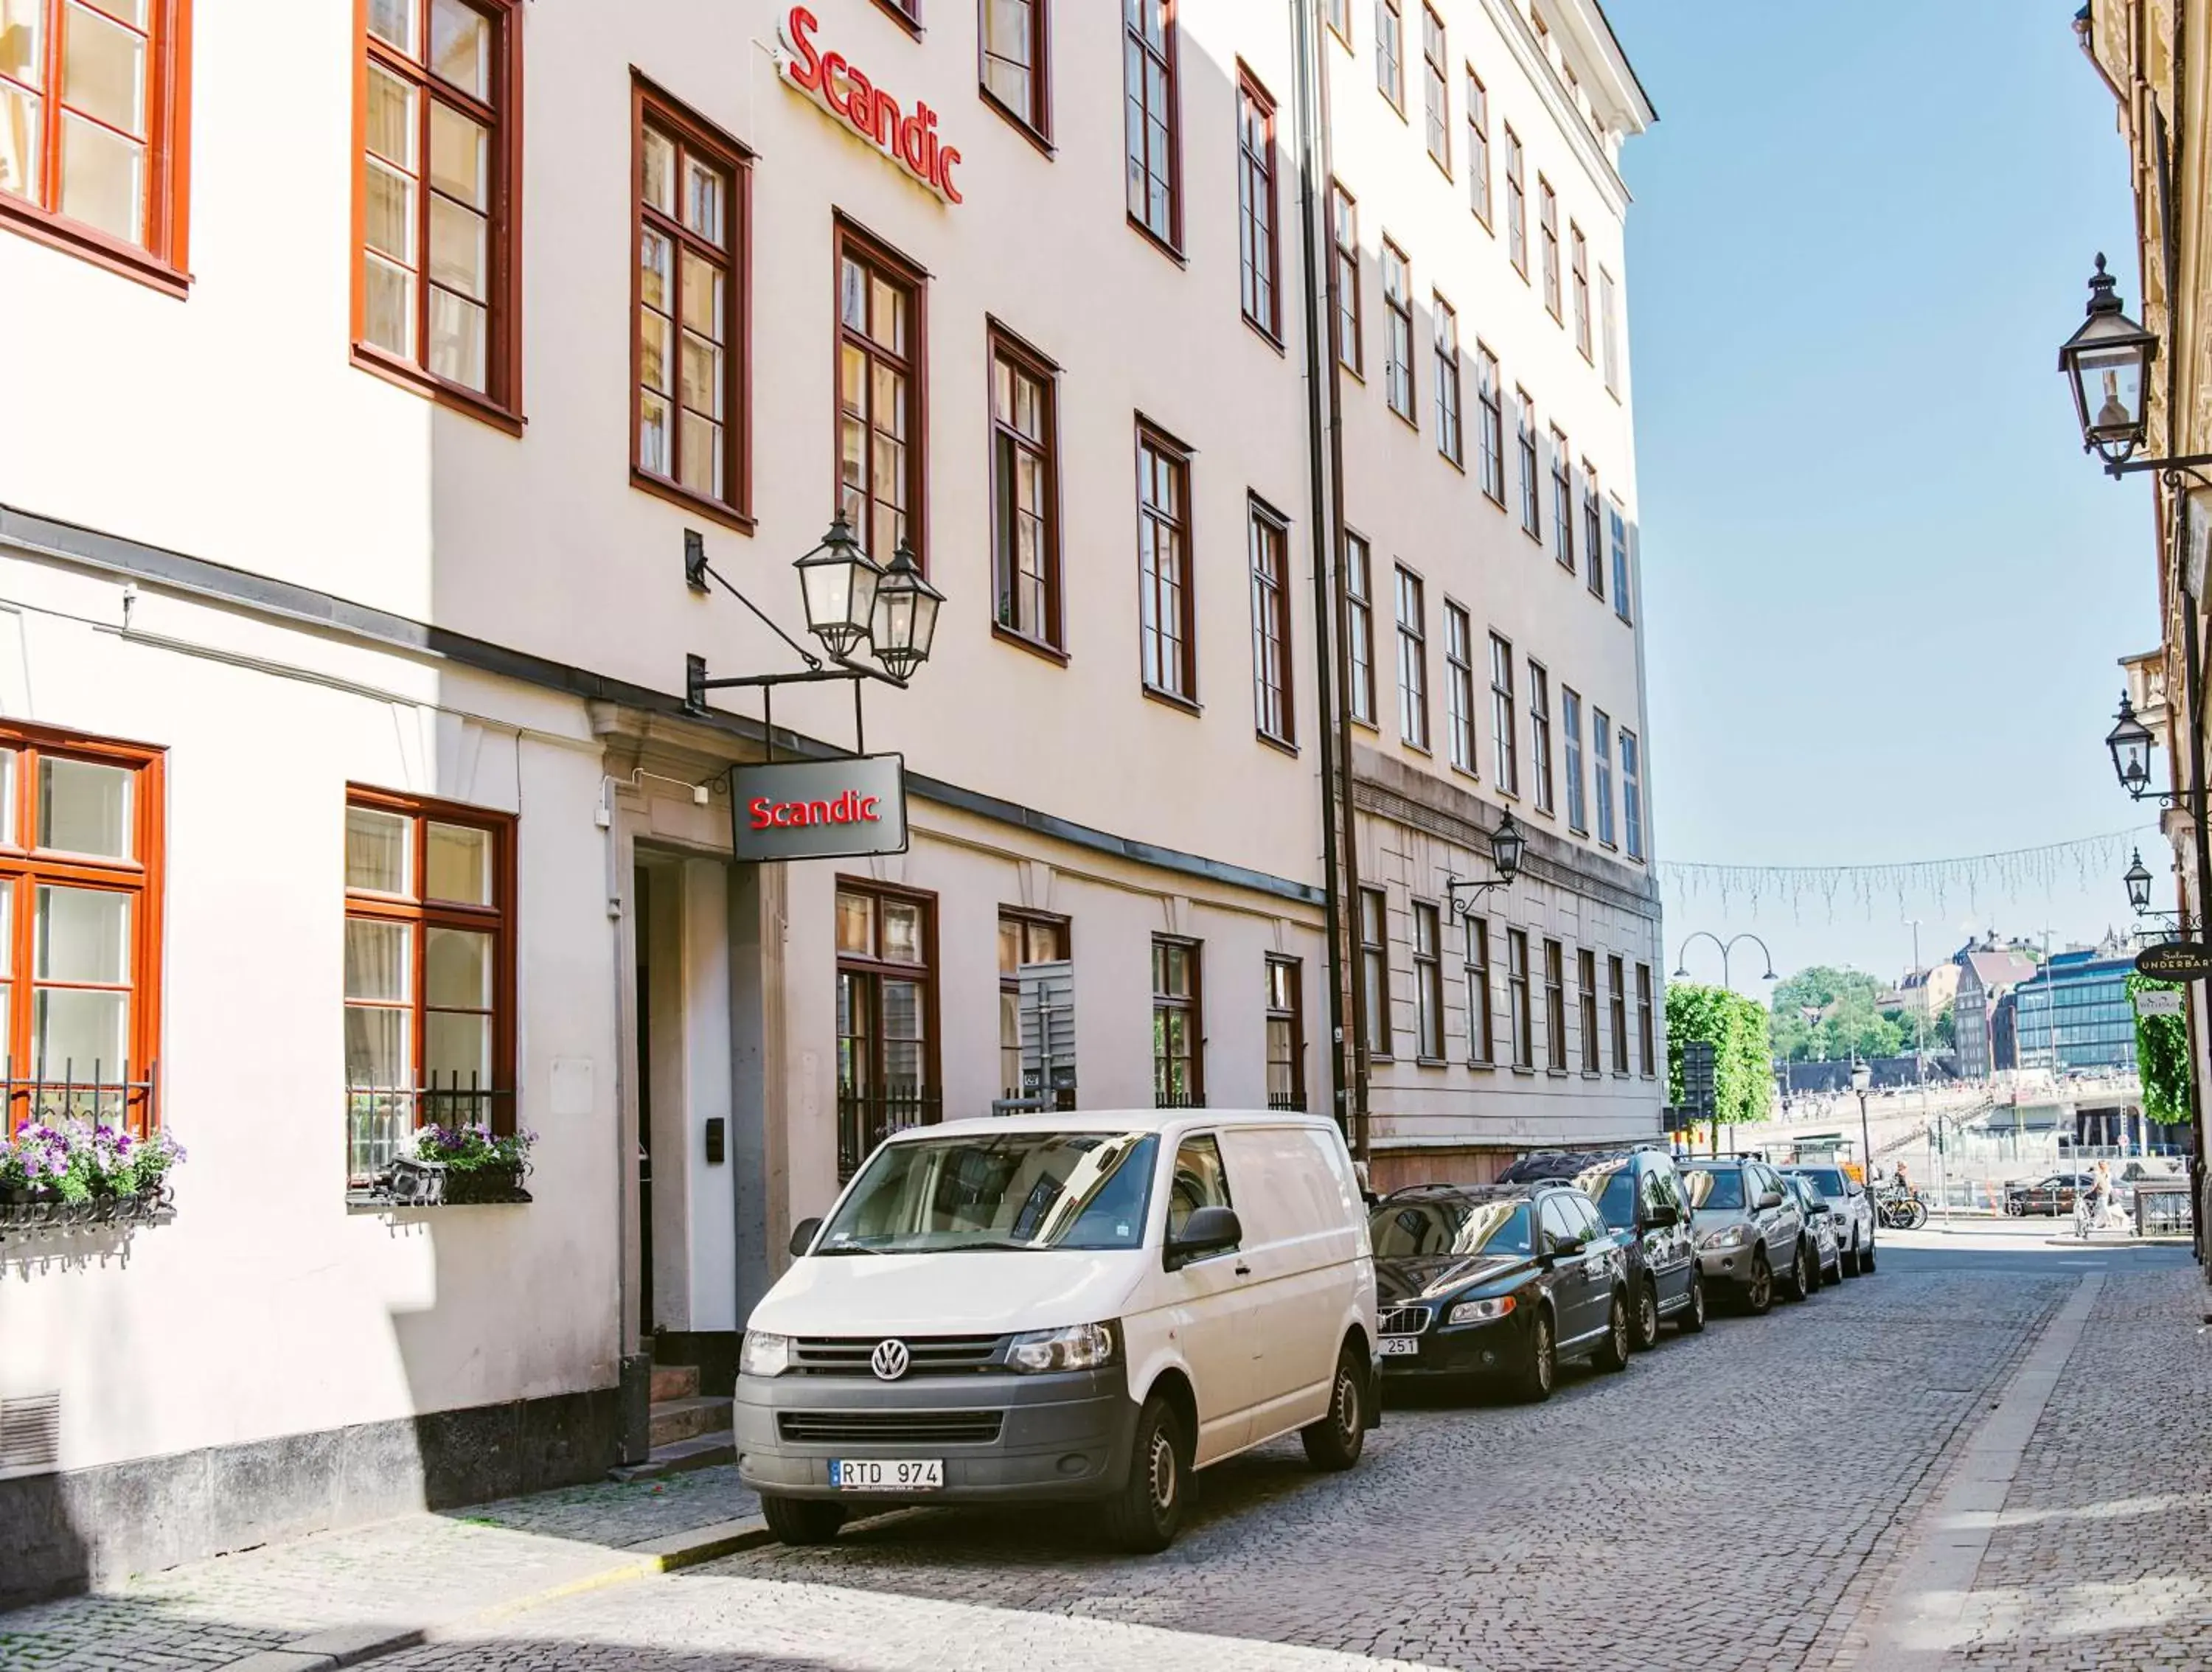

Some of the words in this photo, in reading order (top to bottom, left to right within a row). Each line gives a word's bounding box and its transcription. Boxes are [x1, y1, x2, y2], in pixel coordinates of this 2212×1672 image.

[790, 6, 962, 203] Scandic
[748, 790, 882, 831] Scandic
[844, 1463, 881, 1483] RTD
[897, 1463, 938, 1483] 974
